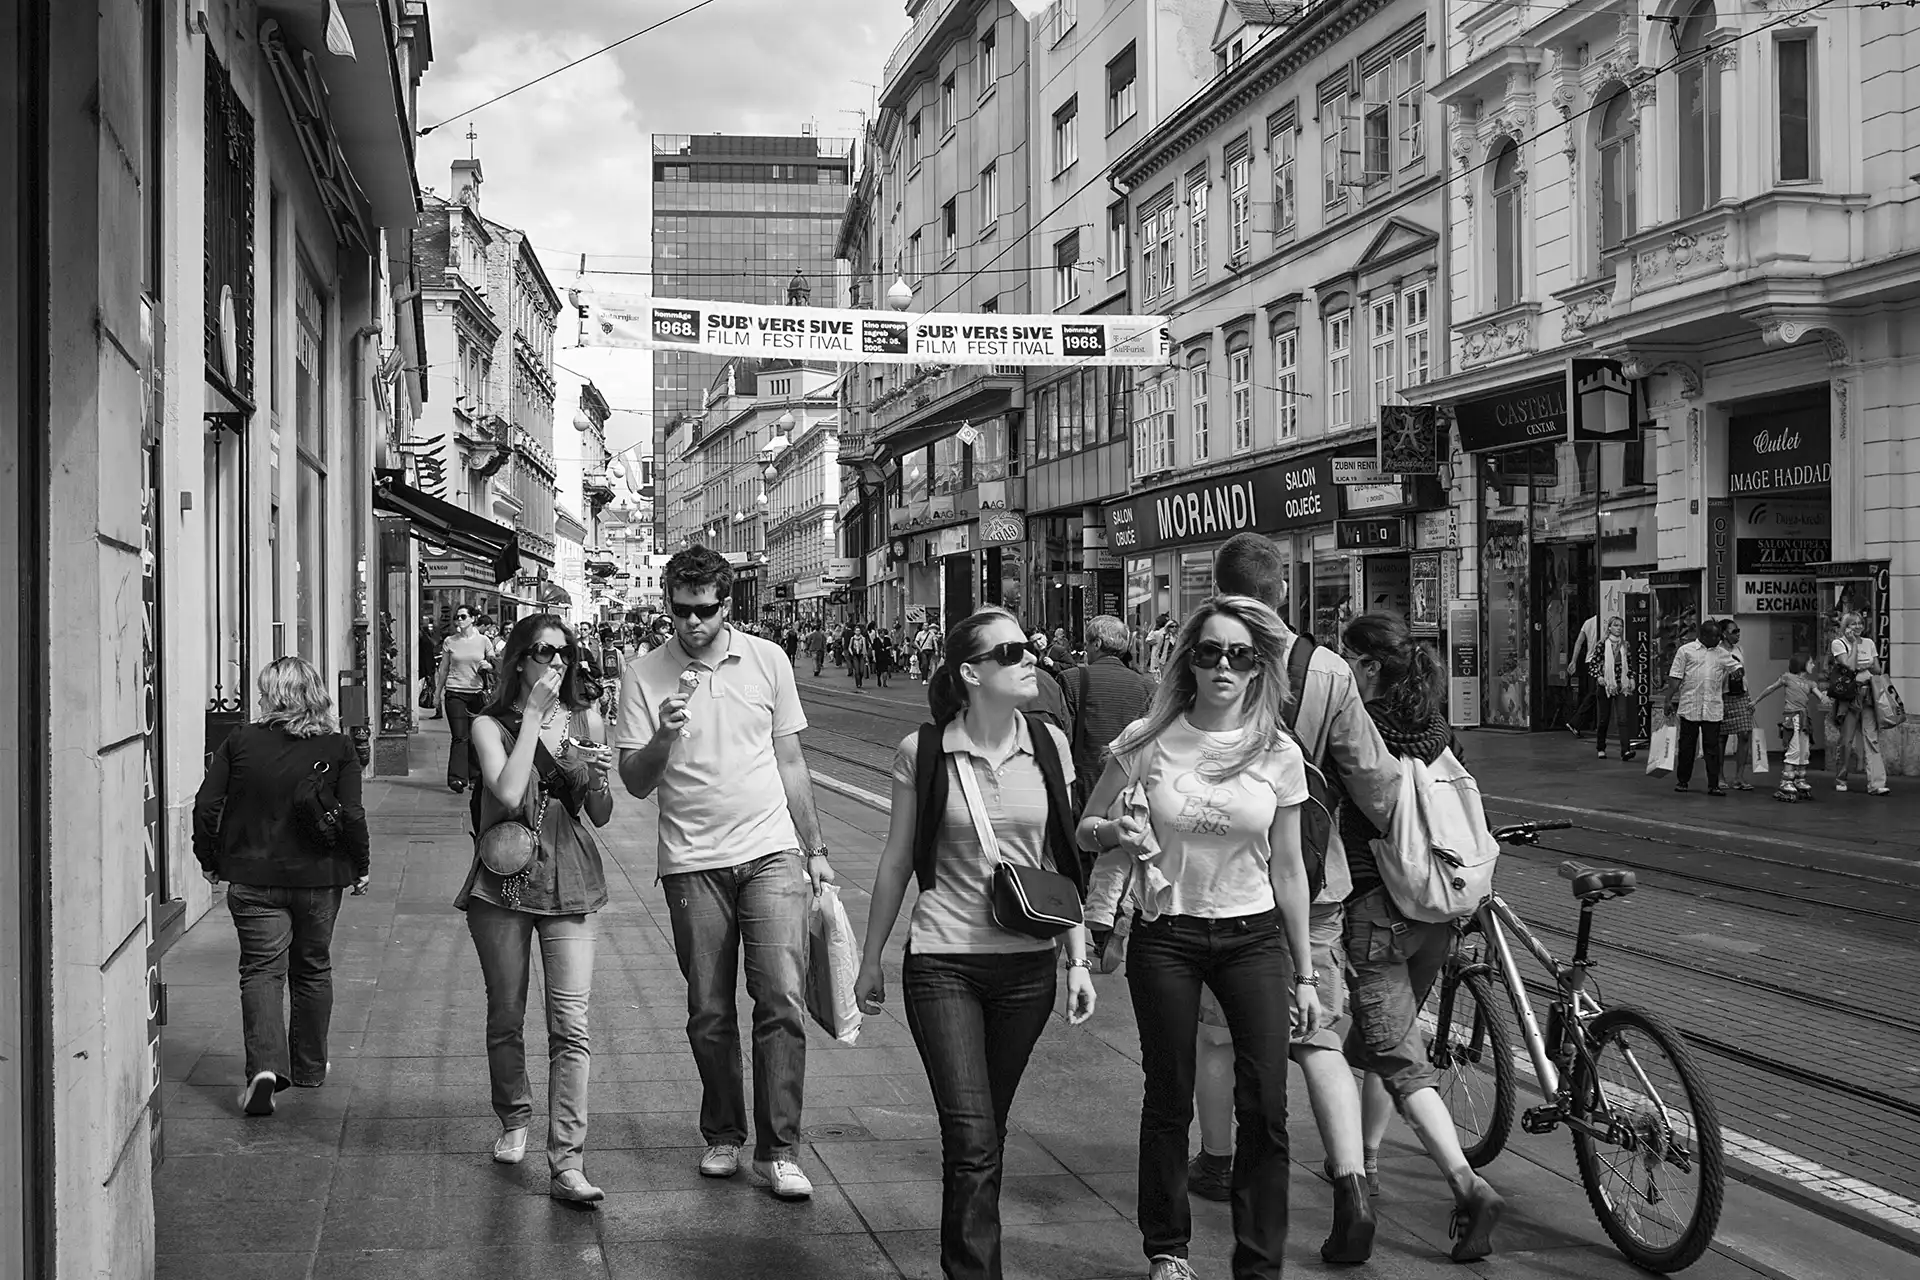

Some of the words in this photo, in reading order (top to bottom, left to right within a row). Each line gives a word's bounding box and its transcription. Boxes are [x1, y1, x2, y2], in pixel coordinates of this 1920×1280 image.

[654, 321, 696, 336] 1968.
[707, 329, 750, 345] FILM
[916, 340, 956, 354] FILM
[1064, 336, 1102, 349] 1968.
[1526, 421, 1557, 435] CENTAR
[1753, 427, 1801, 454] Outlet
[1335, 461, 1357, 470] ZUBNI
[1284, 467, 1317, 491] SALON
[1730, 470, 1770, 492] IMAGE
[1774, 463, 1832, 487] HADDAD
[981, 500, 1005, 510] AAG
[1157, 481, 1257, 540] MORANDI
[1285, 490, 1322, 518] ODJEĆE
[1112, 507, 1134, 526] SALON
[1448, 510, 1457, 546] LIMAR
[1757, 539, 1791, 549] SALON
[1714, 517, 1727, 611] OUTLET
[1760, 549, 1825, 563] ZLATKO
[1638, 631, 1648, 738] RASPRODAJA
